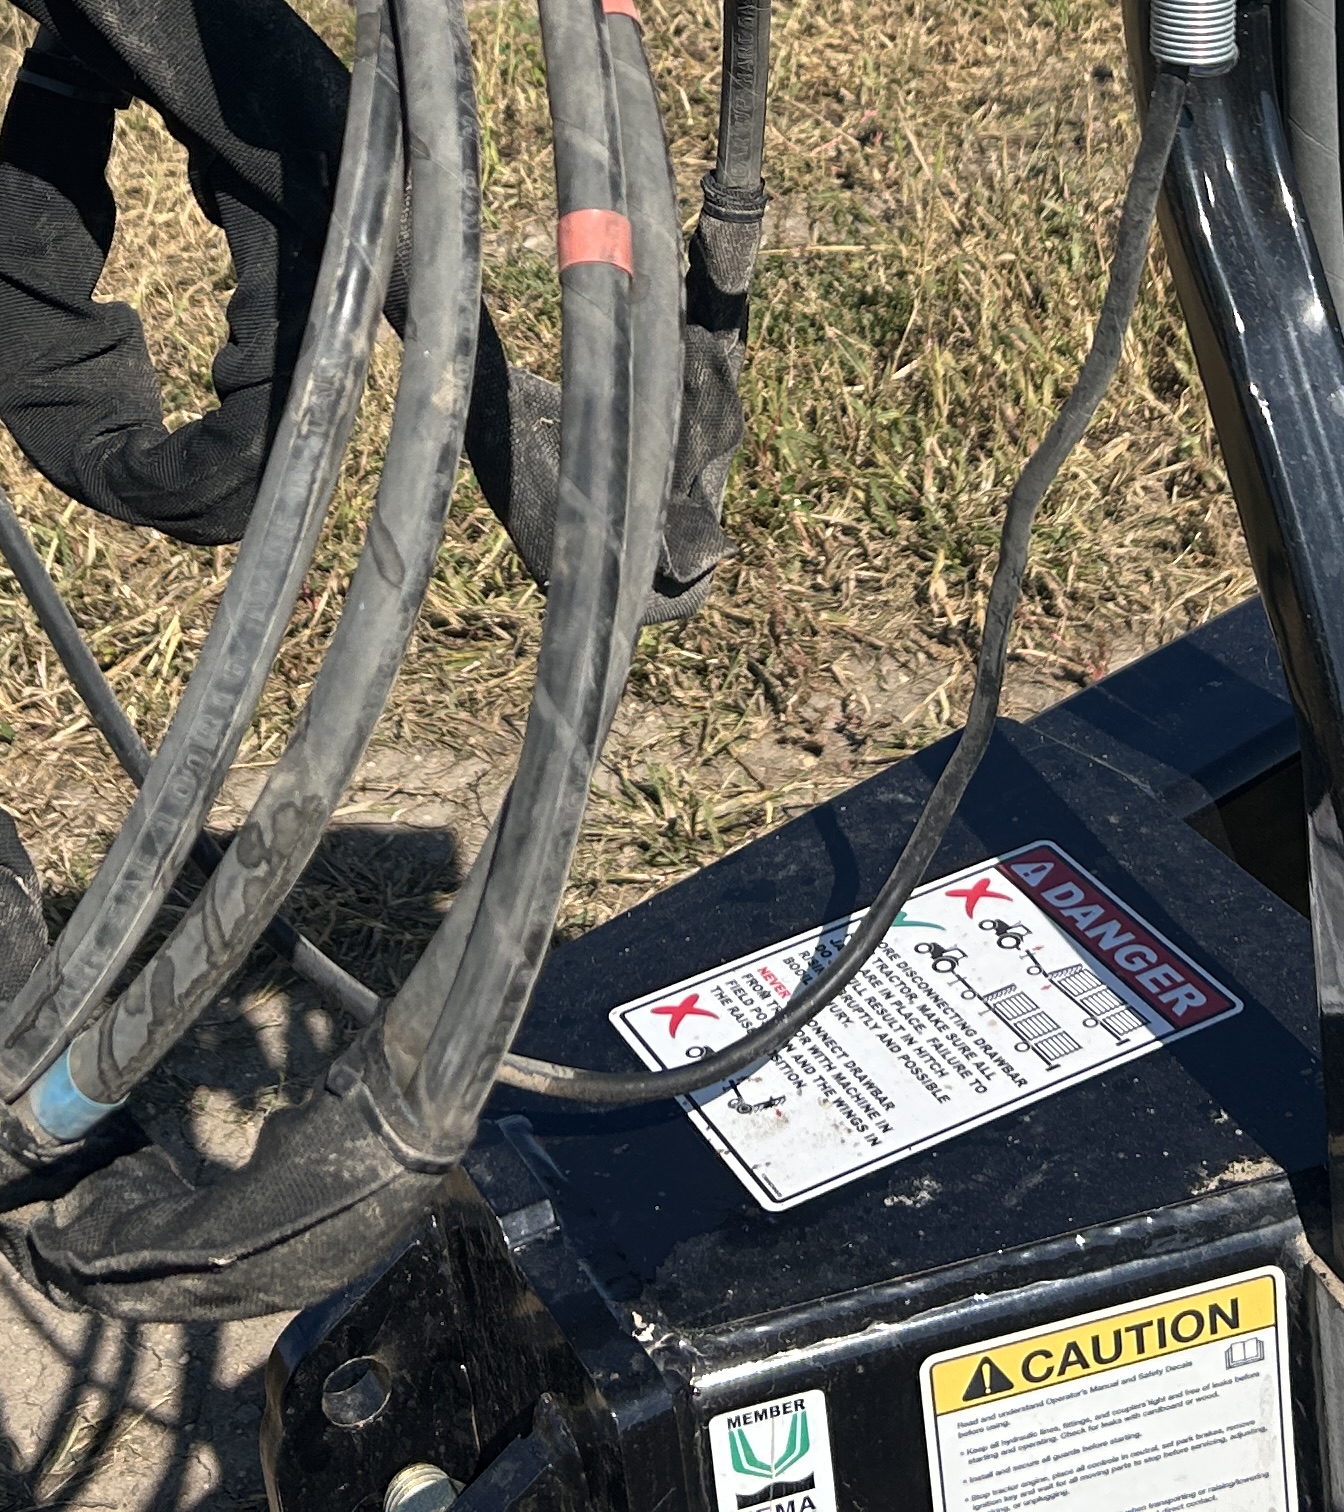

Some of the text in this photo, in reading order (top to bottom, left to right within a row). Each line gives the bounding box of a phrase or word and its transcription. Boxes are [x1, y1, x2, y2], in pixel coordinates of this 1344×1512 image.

[707, 985, 733, 1007] THE
[1035, 880, 1213, 1017] DANGER
[723, 979, 884, 1147] FIELD AND THE WINGS IN
[738, 972, 771, 1000] FROM
[804, 1043, 838, 1072] WITH
[829, 1071, 882, 1120] MACHINE
[874, 1118, 895, 1133] IN
[754, 966, 792, 999] NEVER
[842, 1059, 897, 1111] DRAWBAR
[795, 950, 827, 976] RISIN
[873, 1030, 903, 1054] AND
[896, 1053, 952, 1104] POSSIBLE
[856, 967, 990, 1094] ARE IN PLACE. FAILURE TO
[862, 995, 907, 1034] RESULT
[899, 1032, 919, 1046] IN
[911, 1045, 951, 1078] HITCH
[868, 957, 1000, 1081] TRACTOR, MAKE SURE ALL
[893, 961, 979, 1038] DISCONNECTING
[971, 1037, 1029, 1088] DRAWBAR
[1020, 1295, 1240, 1386] CAUTION
[727, 1399, 806, 1429] MEMBER
